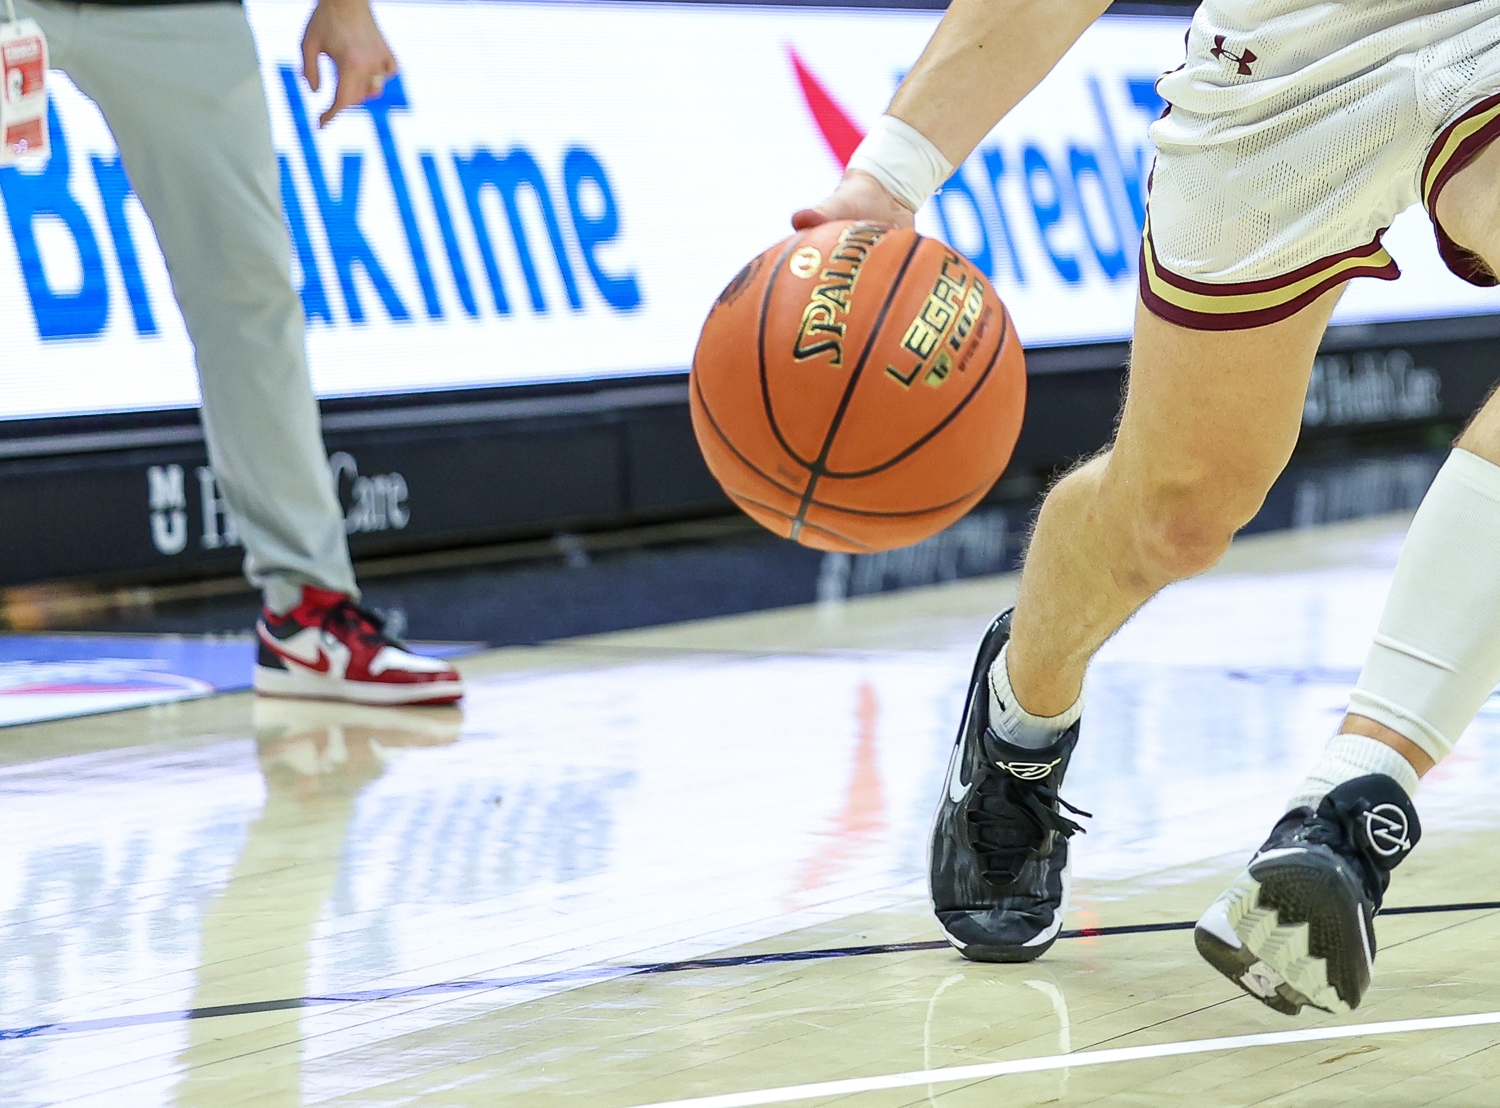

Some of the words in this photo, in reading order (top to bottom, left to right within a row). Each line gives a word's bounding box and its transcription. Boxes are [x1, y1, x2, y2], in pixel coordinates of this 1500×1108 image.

[0, 64, 645, 342] BrkTime
[793, 221, 888, 368] SPALDIN
[884, 246, 968, 391] LEGACY
